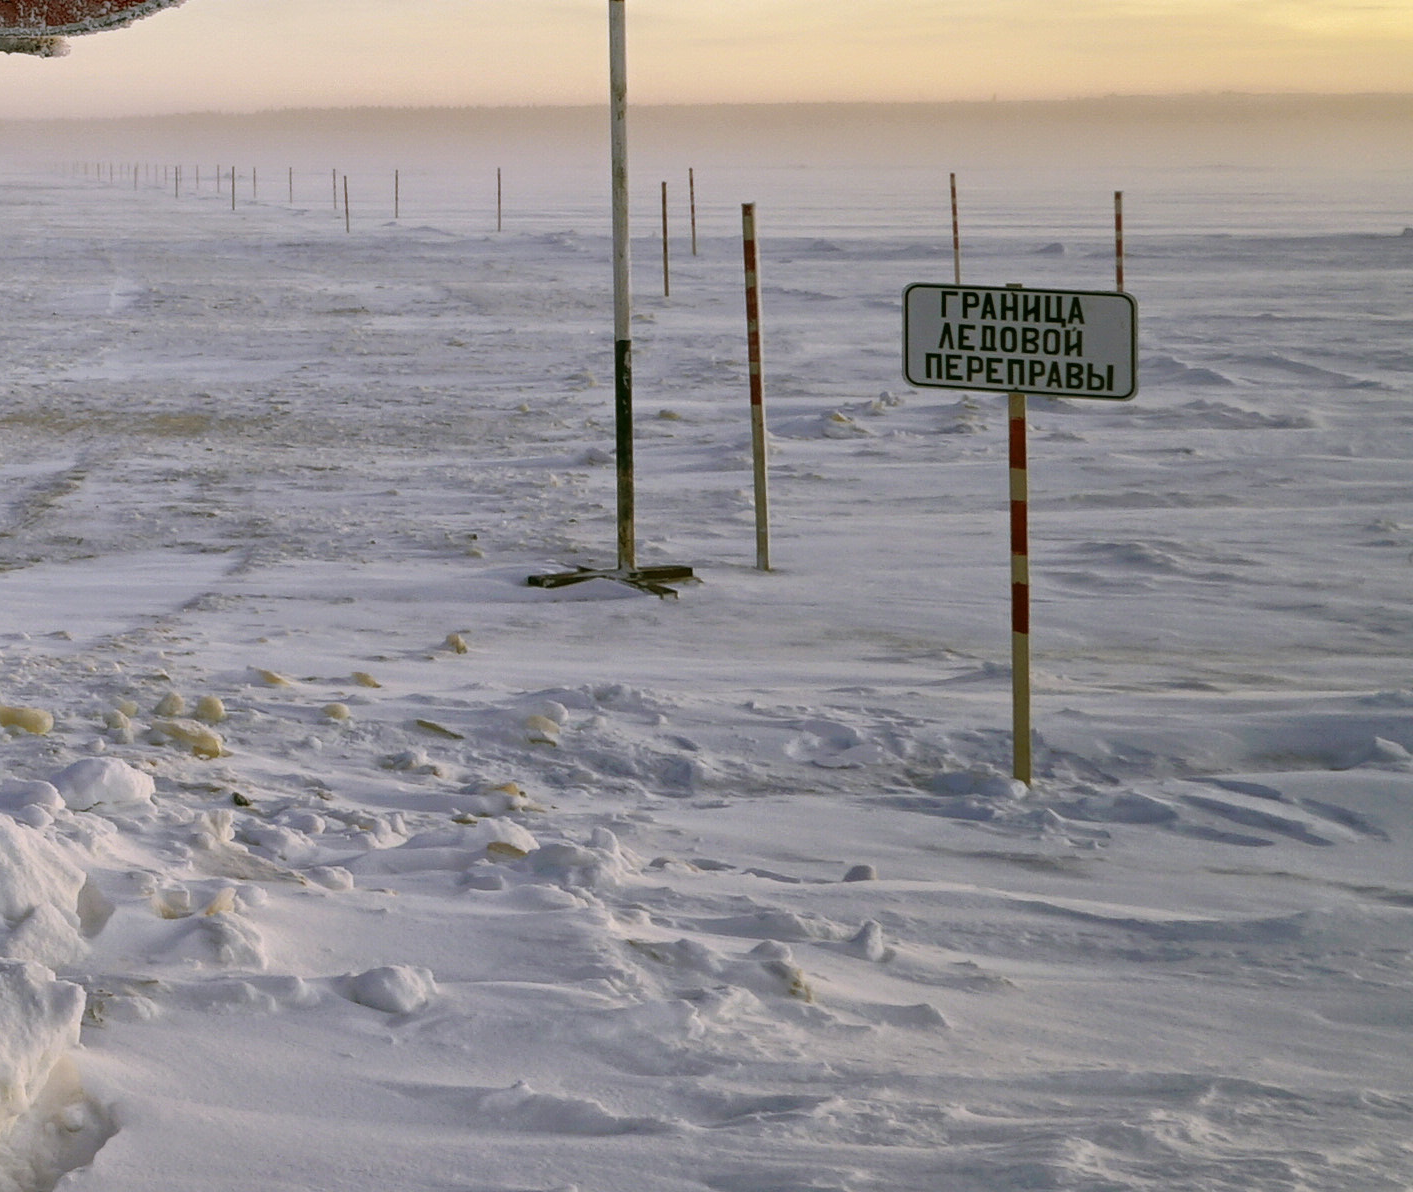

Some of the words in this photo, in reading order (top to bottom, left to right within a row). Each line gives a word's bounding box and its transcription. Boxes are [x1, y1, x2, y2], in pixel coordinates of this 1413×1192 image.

[941, 290, 1085, 327] ГРАНИЦА
[938, 322, 1083, 357] ЛЕДОВОЙ
[925, 352, 1114, 391] ПЕРЕПРАВЫ
